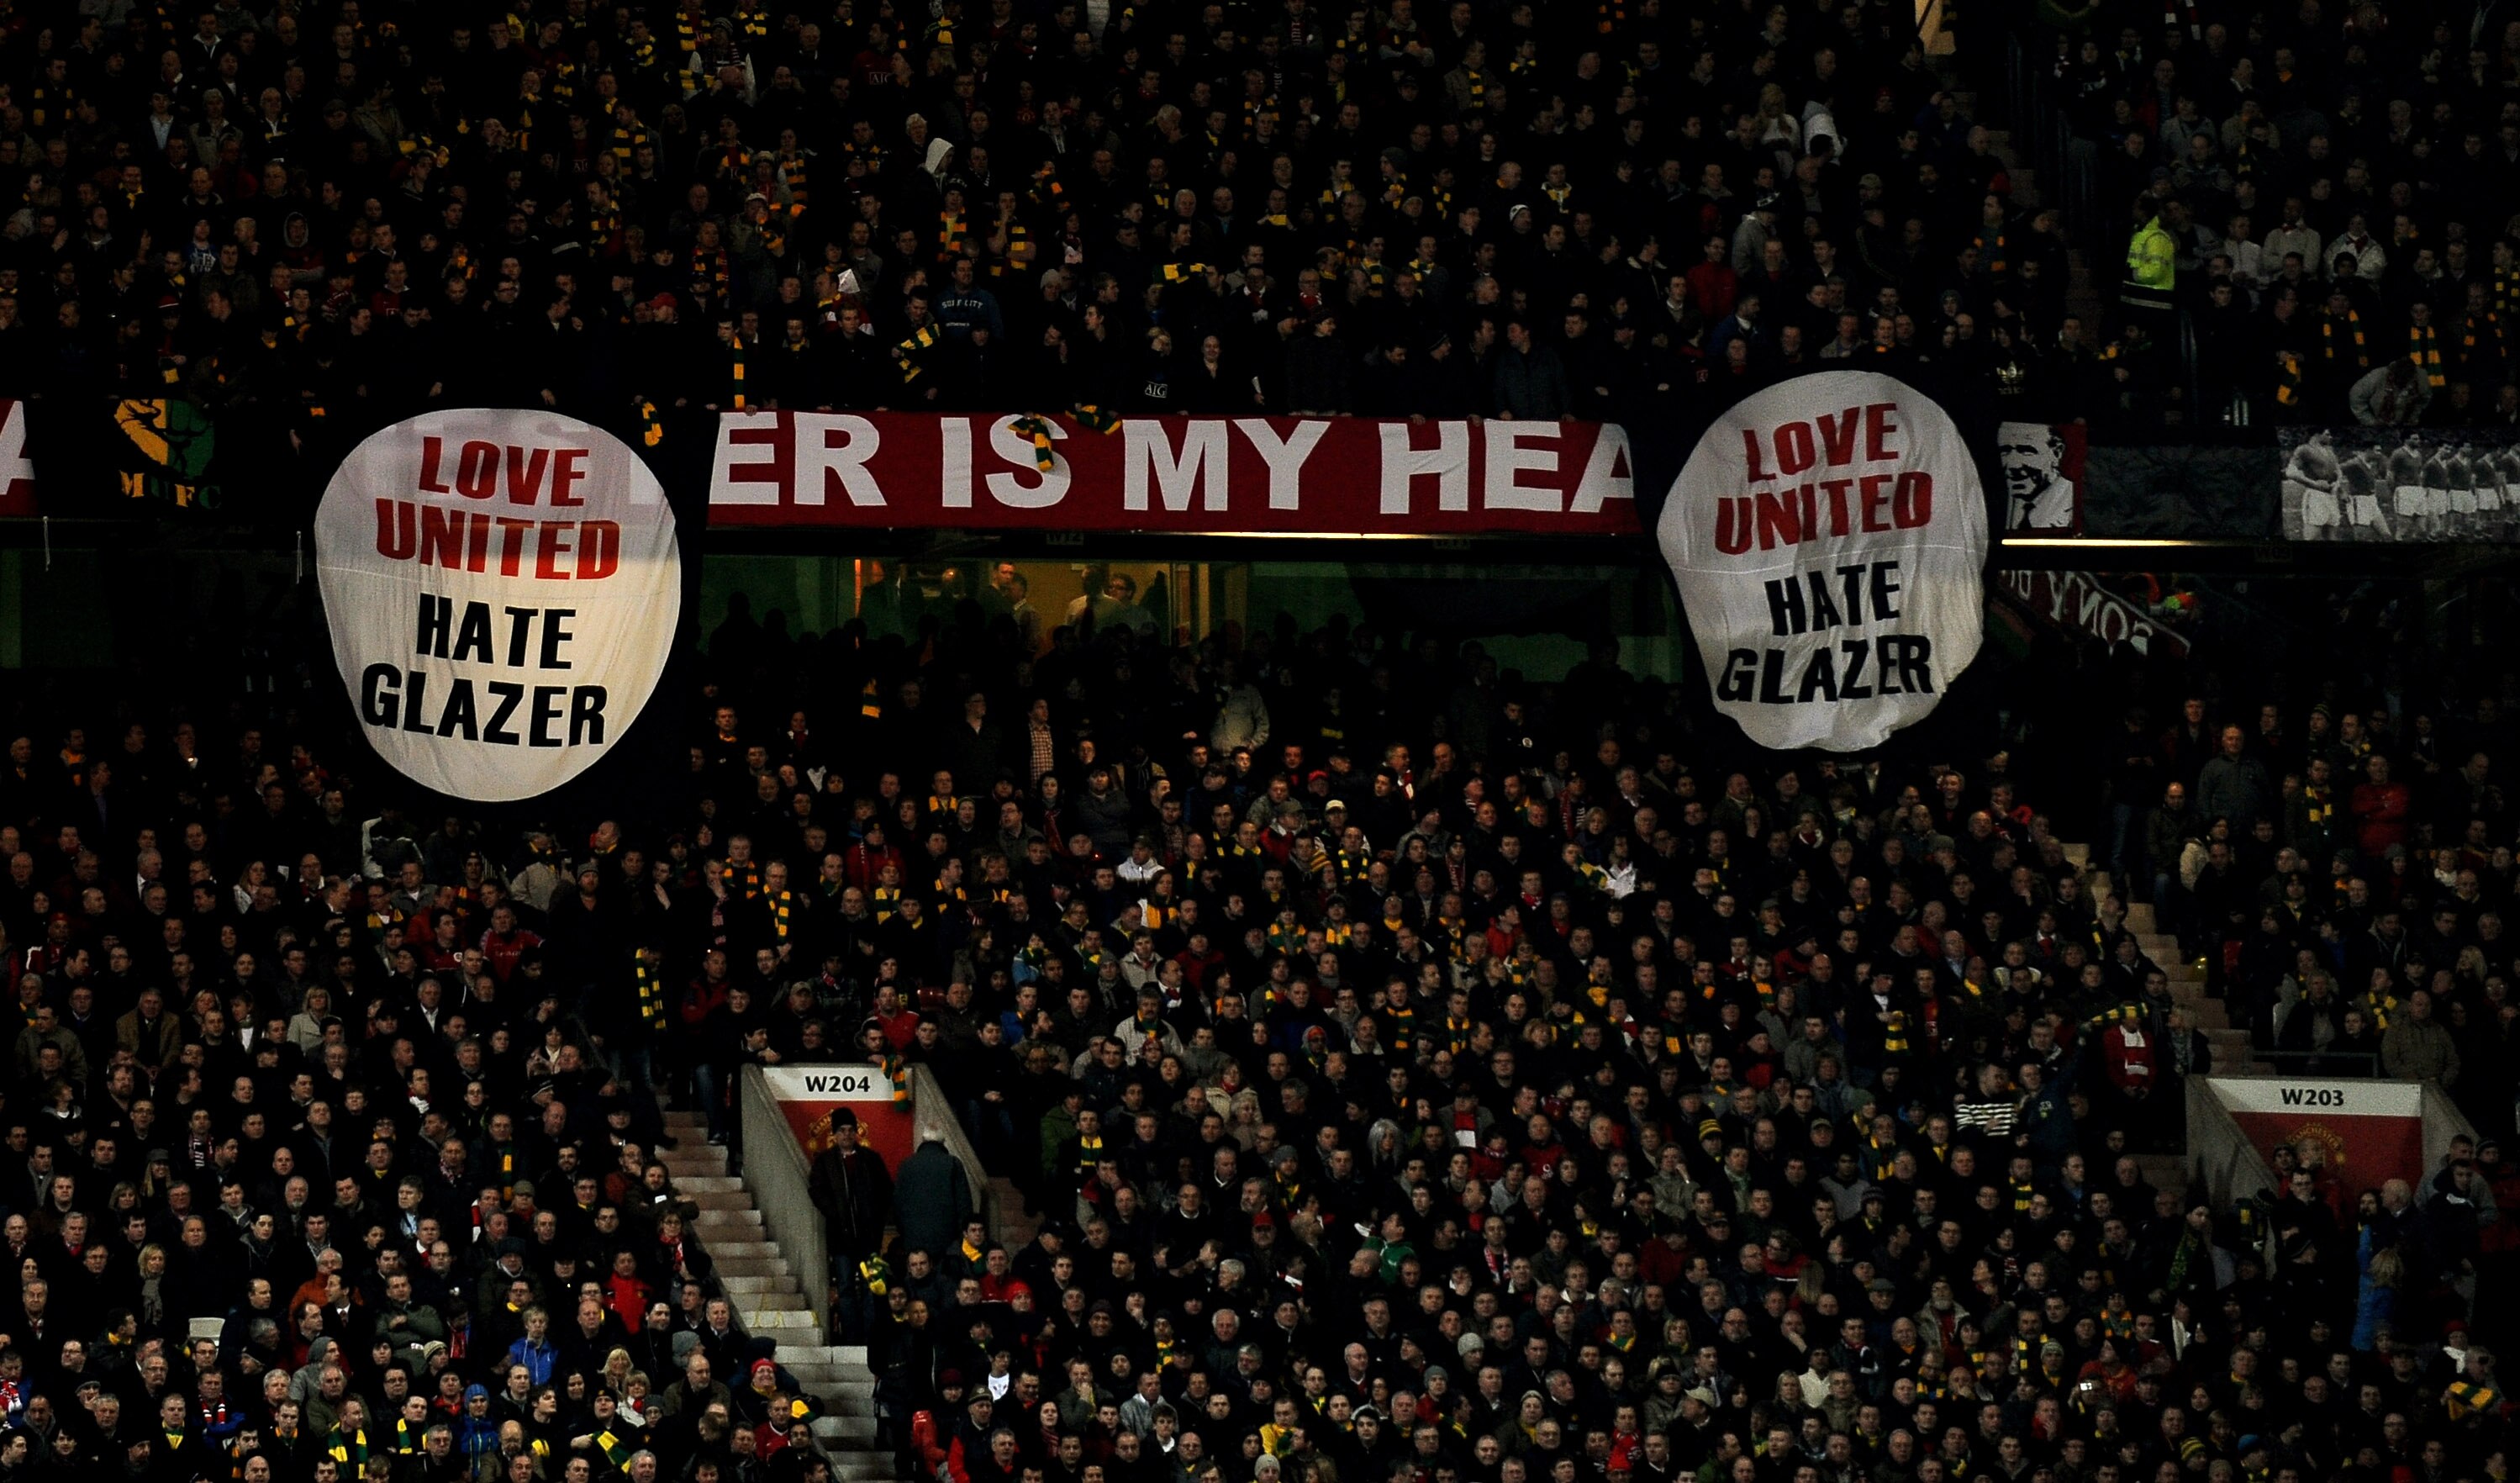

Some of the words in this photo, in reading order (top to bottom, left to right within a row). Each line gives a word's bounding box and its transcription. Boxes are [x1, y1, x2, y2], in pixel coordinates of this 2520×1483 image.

[1146, 383, 1167, 397] AIG
[419, 435, 589, 507] LOVE
[940, 414, 1072, 509] IS
[1123, 418, 1332, 511] MY
[1742, 403, 1899, 483] LOVE
[118, 469, 223, 510] MUFC
[1715, 471, 1932, 556] UNITED
[376, 498, 620, 580] UNITED
[416, 593, 577, 670] HATE
[1764, 561, 1901, 636] HATE
[361, 662, 608, 747] GLAZER
[1716, 635, 1935, 705] GLAZER
[805, 1075, 870, 1092] W204
[2281, 1088, 2343, 1106] W203
